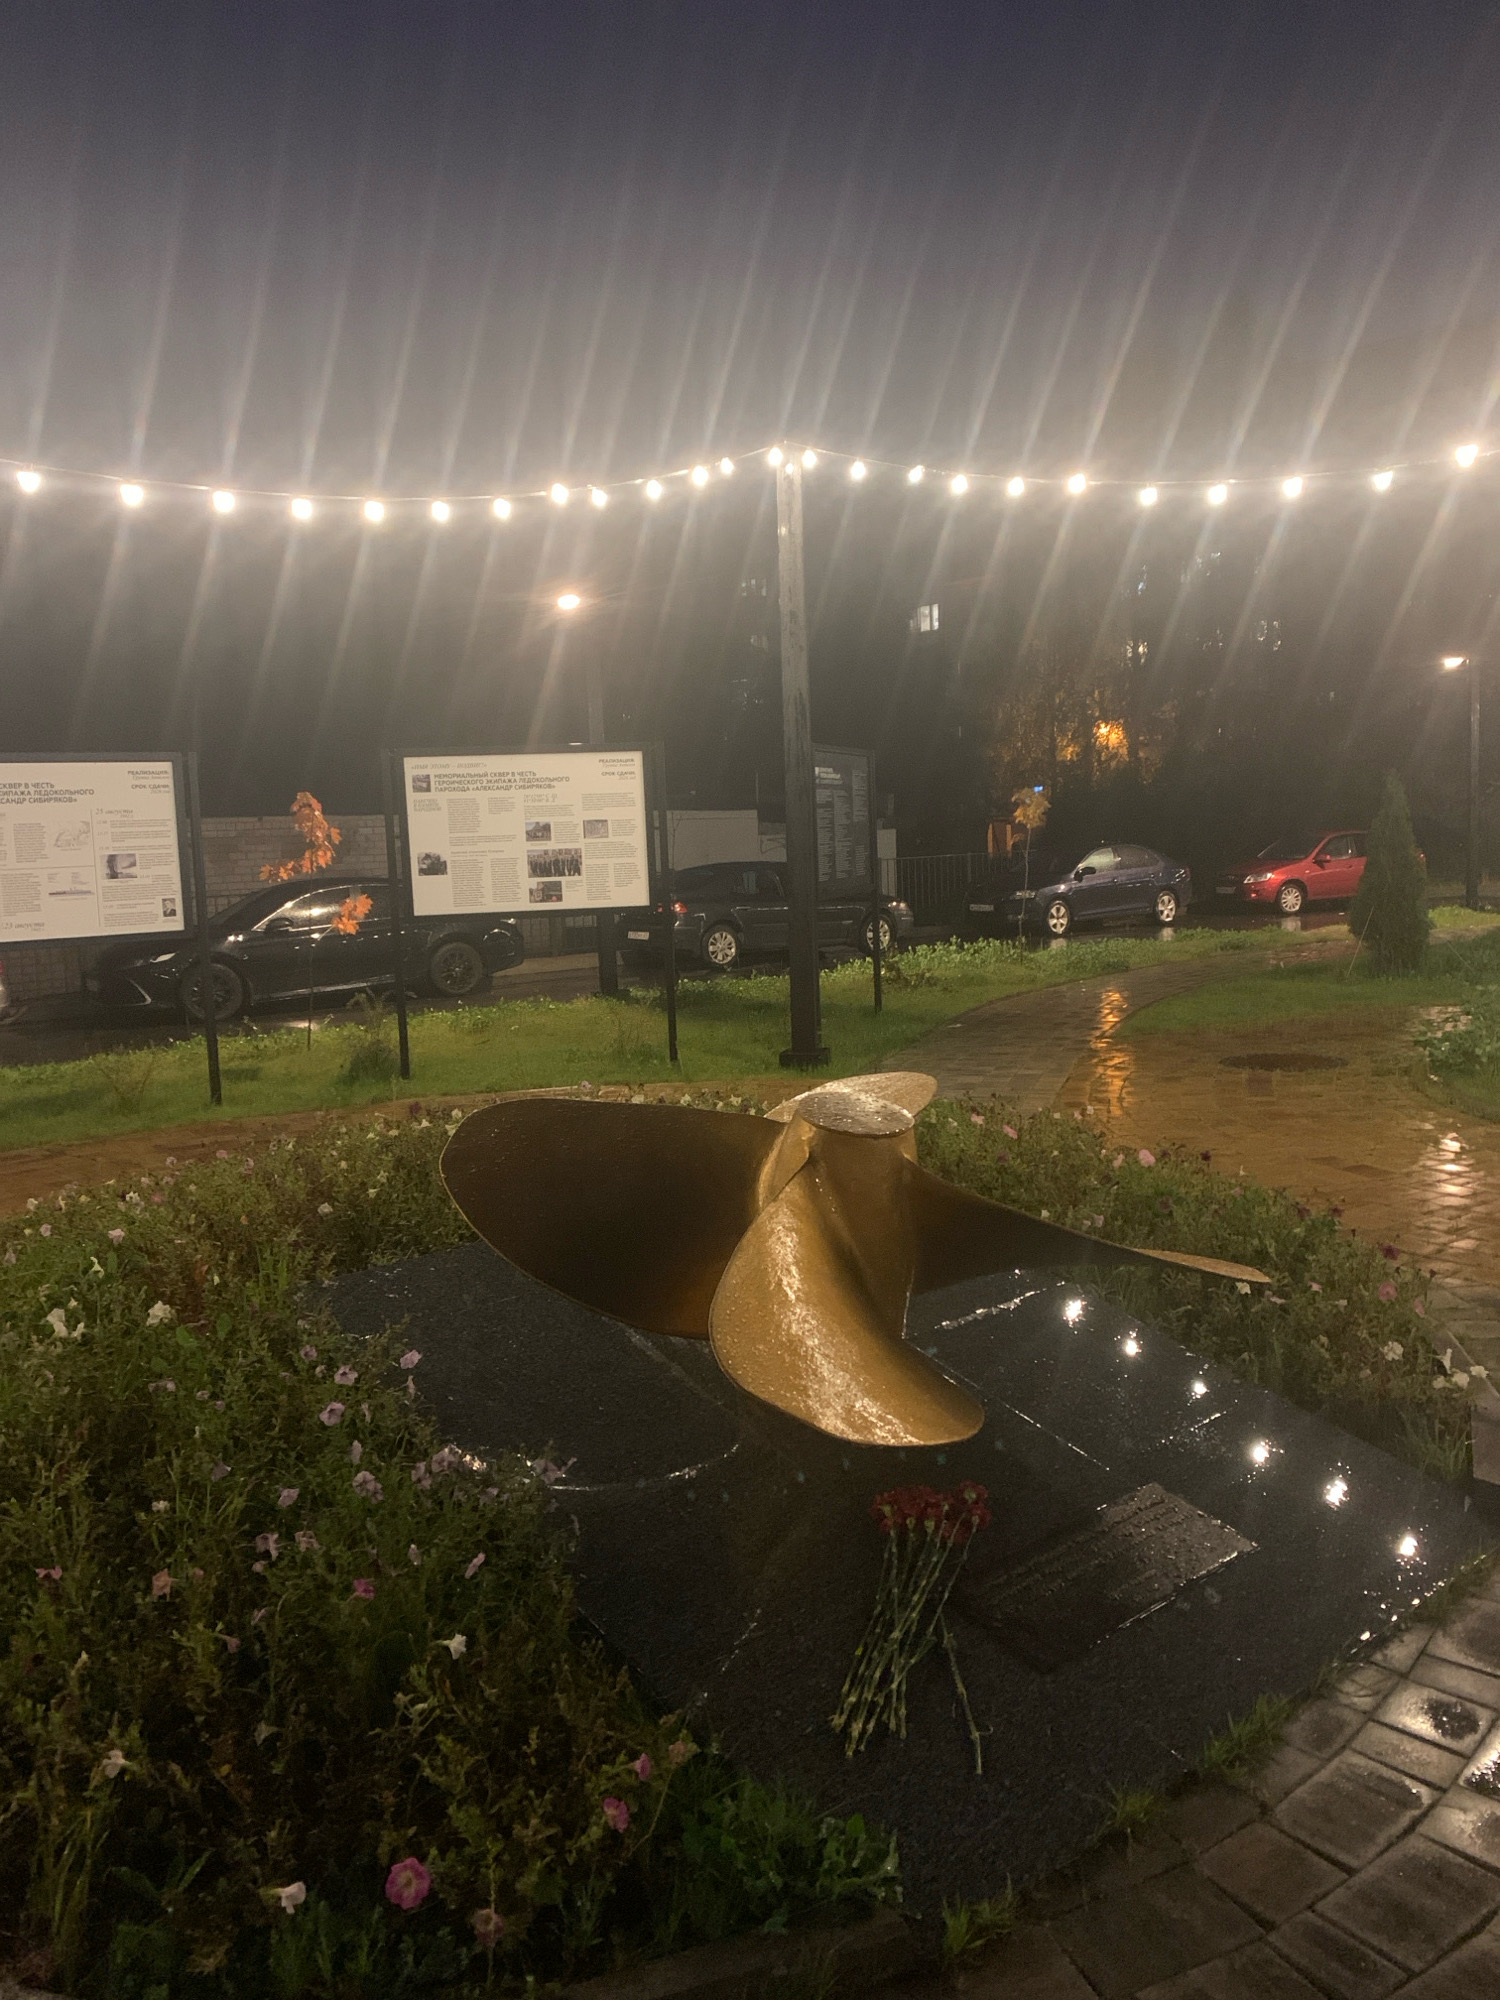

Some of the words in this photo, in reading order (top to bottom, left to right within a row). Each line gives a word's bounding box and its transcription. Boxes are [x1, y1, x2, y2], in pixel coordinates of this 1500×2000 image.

[434, 771, 489, 779] МЕМОРИАЛЬНЫЙ
[519, 776, 570, 784] ЛЕДОКОЛЬНОГО
[472, 784, 514, 792] «АЛЕКСАНДР
[515, 783, 556, 791] СИБИРЯКОВ»
[33, 788, 95, 797] ЛЕДОКОЛЬНОГО
[28, 796, 78, 804] СИБИРЯКОВ»
